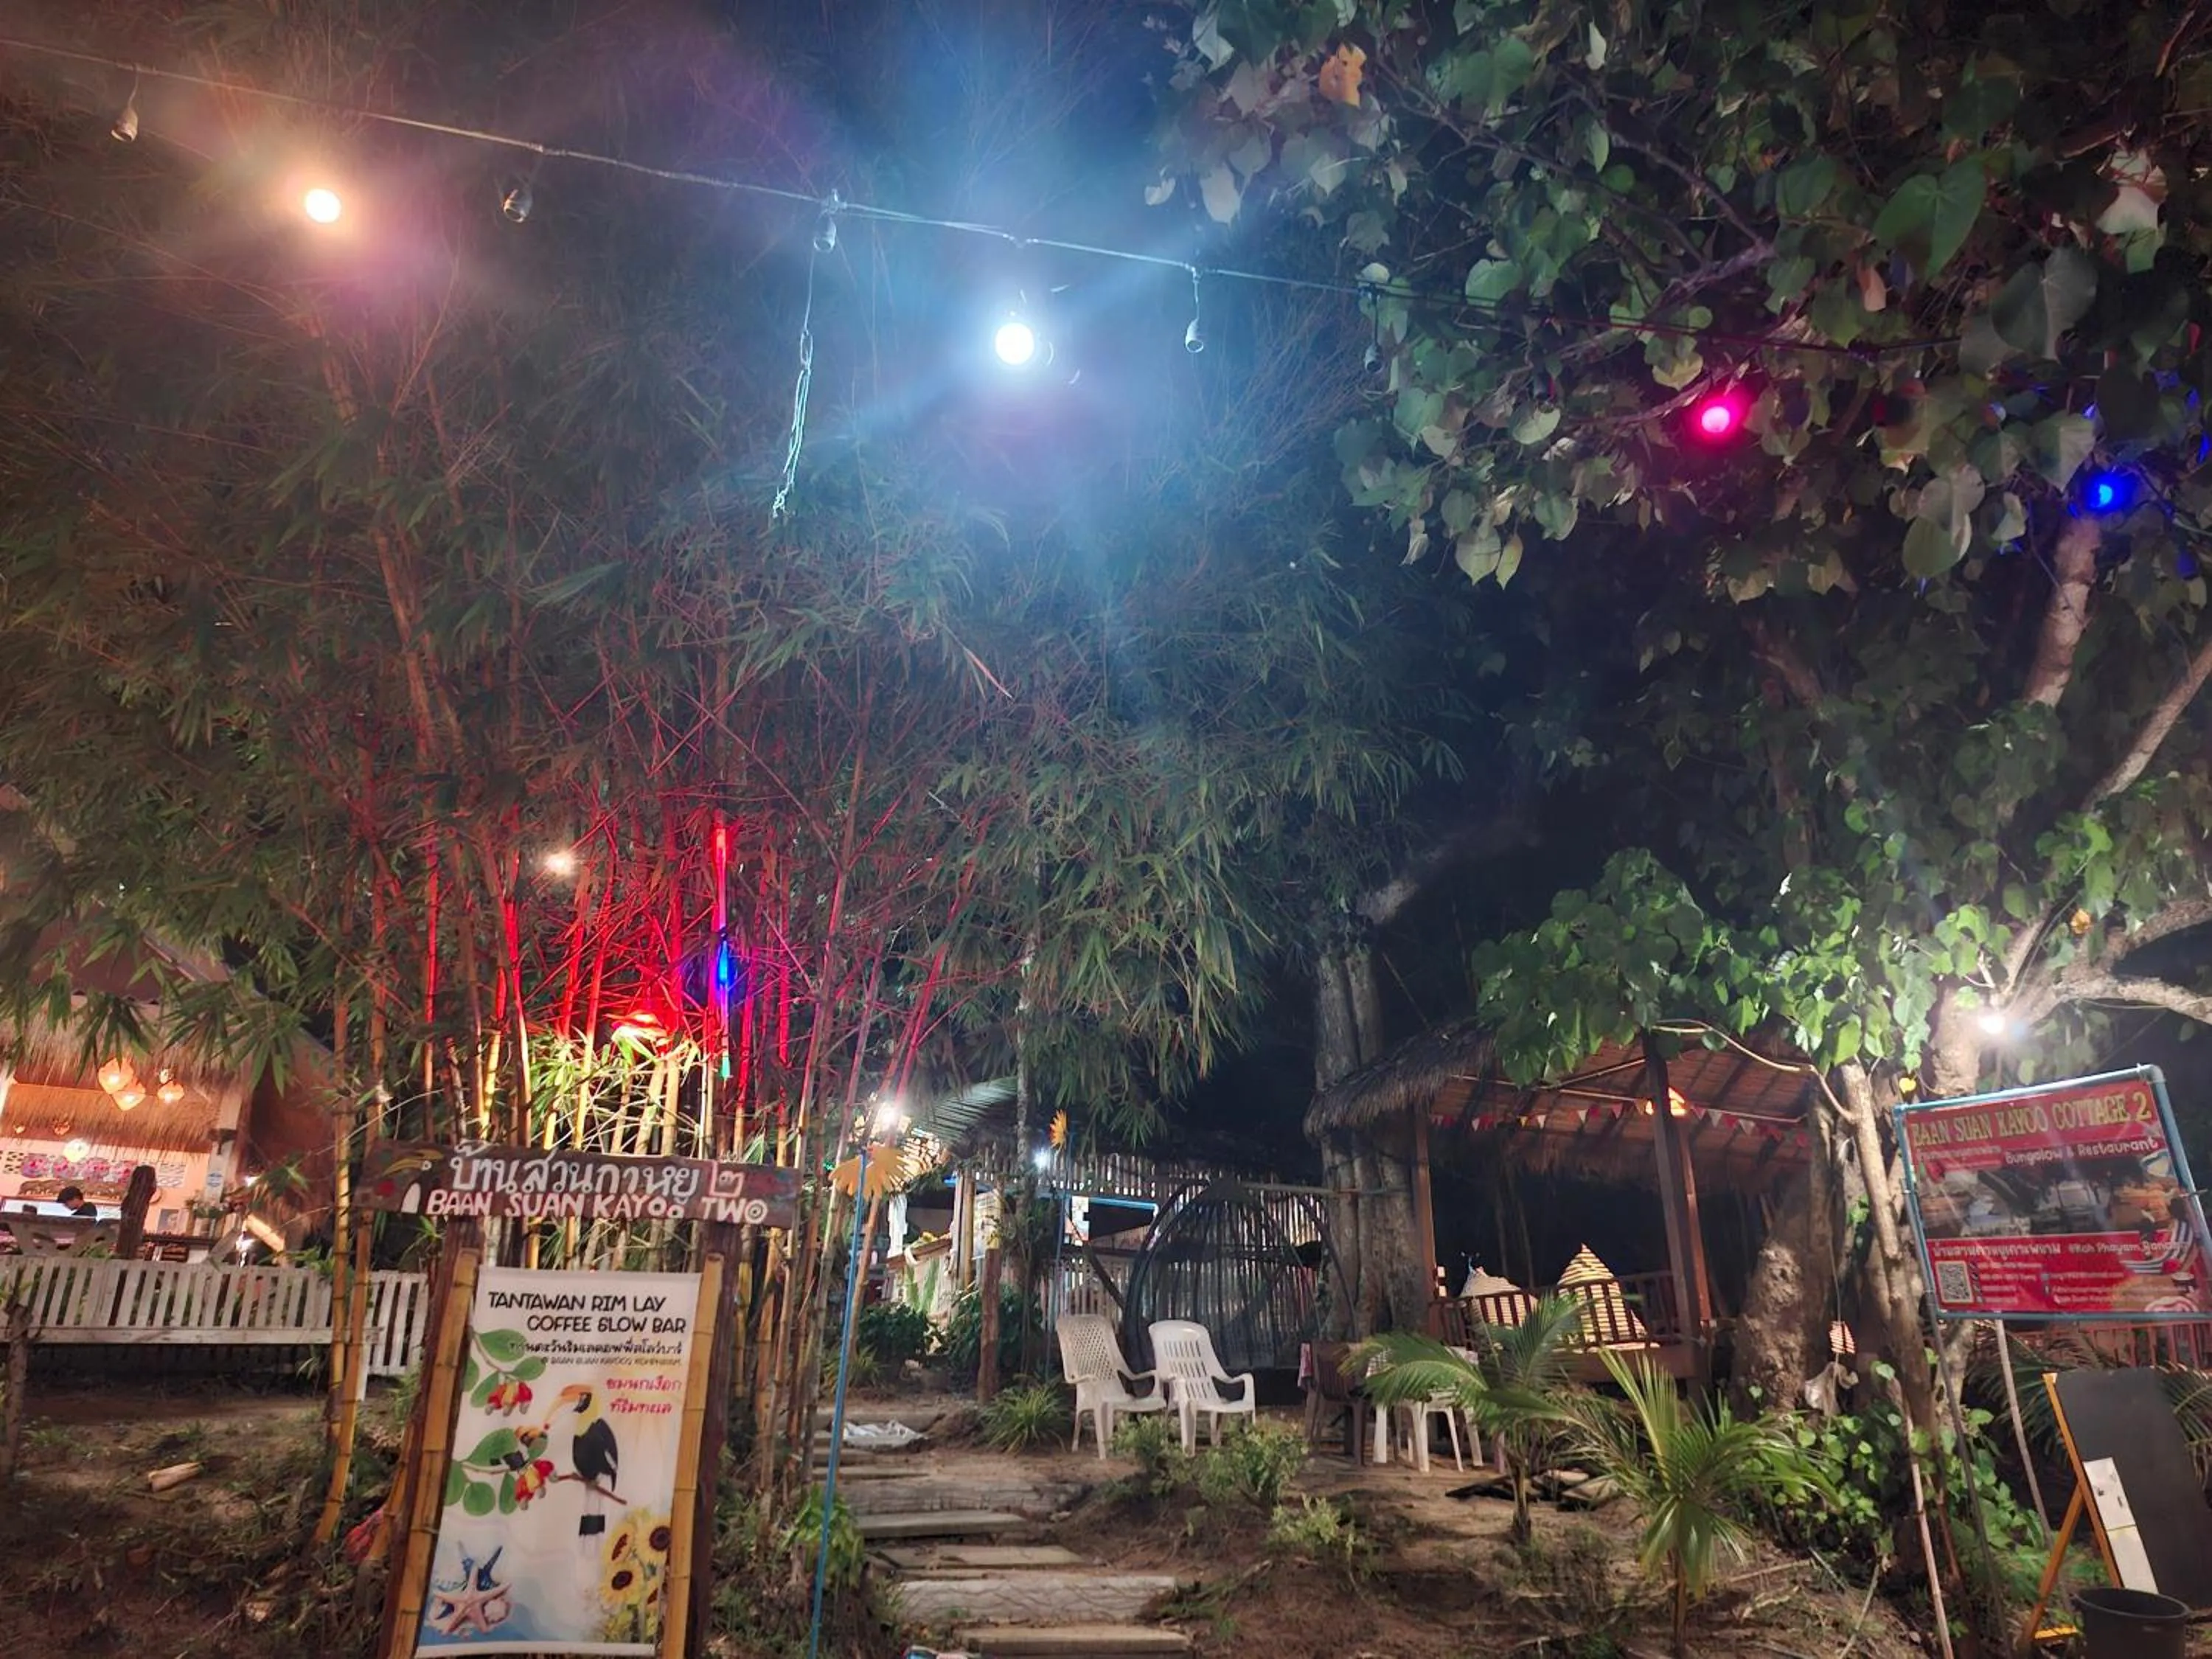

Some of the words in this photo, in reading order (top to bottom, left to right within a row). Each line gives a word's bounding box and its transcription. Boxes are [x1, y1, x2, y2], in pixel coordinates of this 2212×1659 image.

[1910, 1119, 1951, 1146] BAAN
[1954, 1113, 1993, 1141] SUAN
[1994, 1105, 2048, 1137] KAYOO
[2052, 1093, 2131, 1130] COTTAGE
[2132, 1091, 2152, 1121] 2
[2005, 1148, 2063, 1166] Bungalow
[2077, 1136, 2159, 1157] Restaurant
[450, 1140, 700, 1204] บ้านสวนกาหยู
[426, 1189, 493, 1217] BAAN
[504, 1192, 585, 1217] SUAN
[592, 1193, 685, 1220] KAYOO
[701, 1197, 768, 1225] TWO
[488, 1291, 586, 1311] TANTAWAN
[591, 1295, 627, 1312] RIM
[633, 1295, 667, 1312] LAY
[526, 1315, 592, 1332] COFFEE
[651, 1317, 686, 1334] BAR
